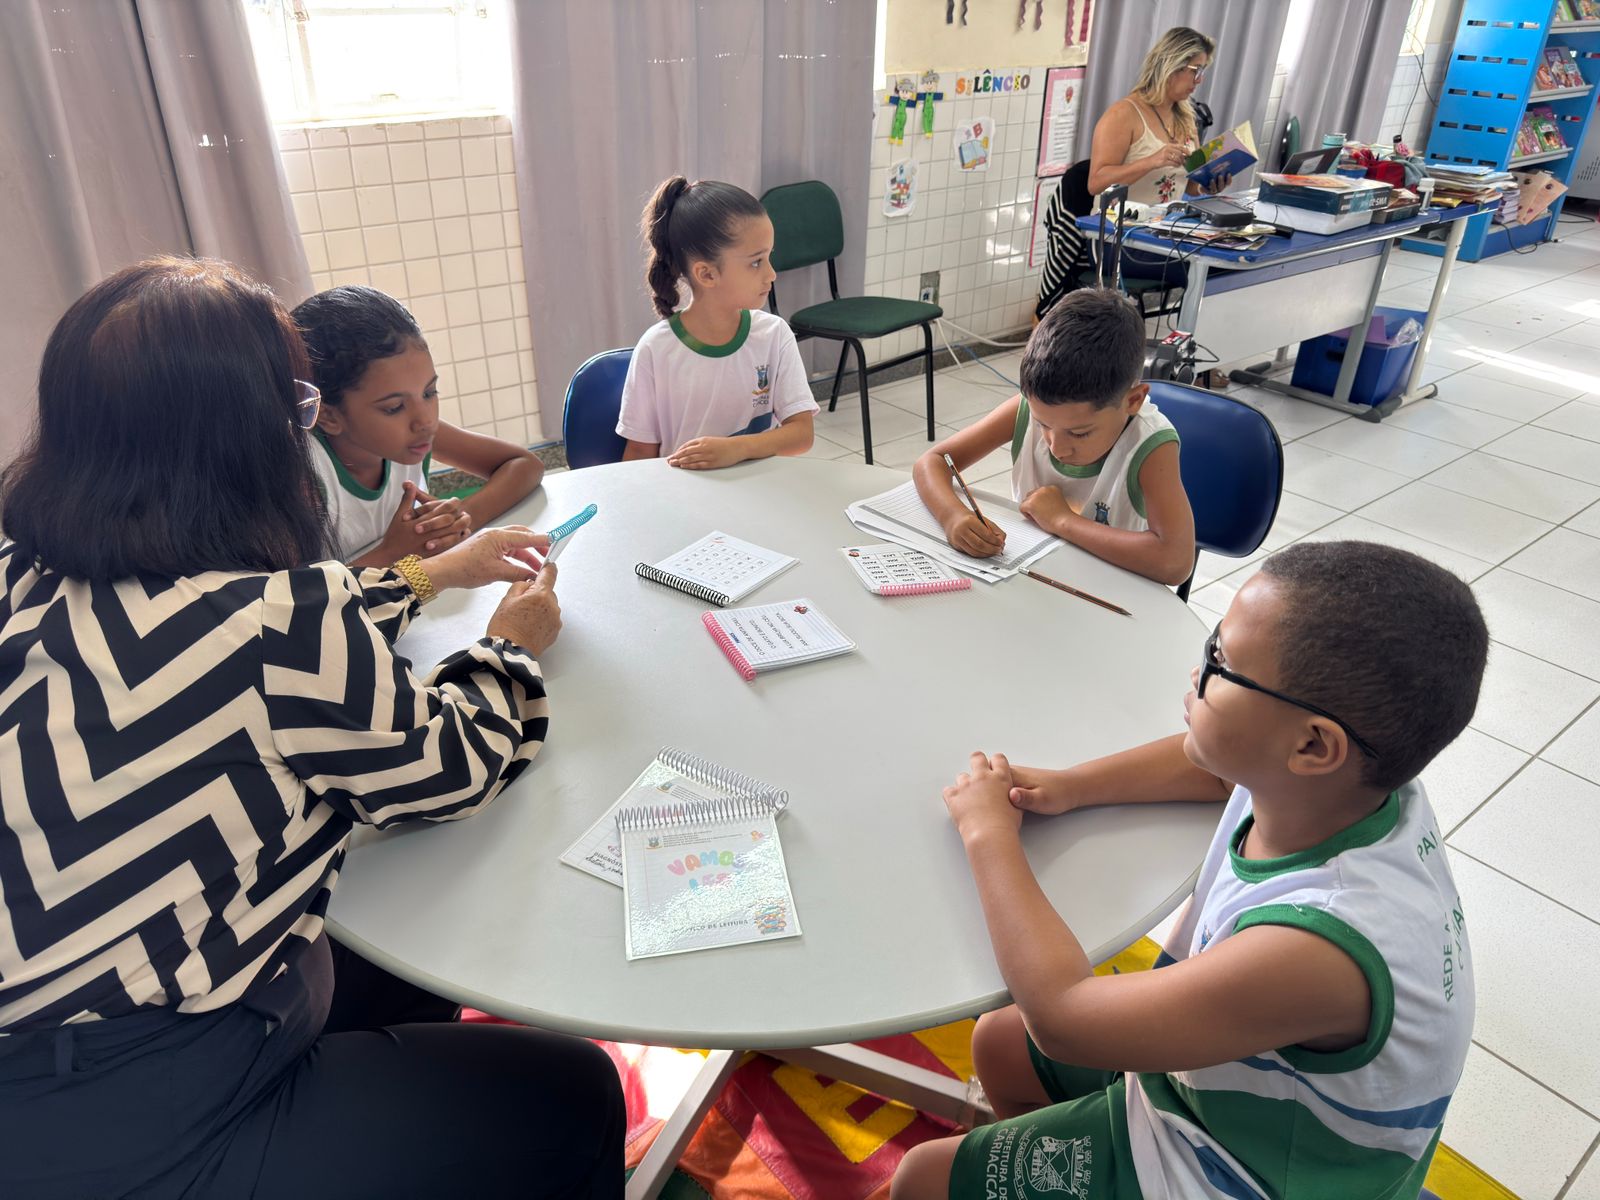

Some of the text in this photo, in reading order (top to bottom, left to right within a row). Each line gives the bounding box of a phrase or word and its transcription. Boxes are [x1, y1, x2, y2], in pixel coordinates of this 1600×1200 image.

[955, 69, 1030, 96] SILÊNCIO
[1444, 943, 1454, 1002] REDE
[985, 1127, 1009, 1200] CARIACICA
[999, 1126, 1018, 1200] PREFEITURA DE
